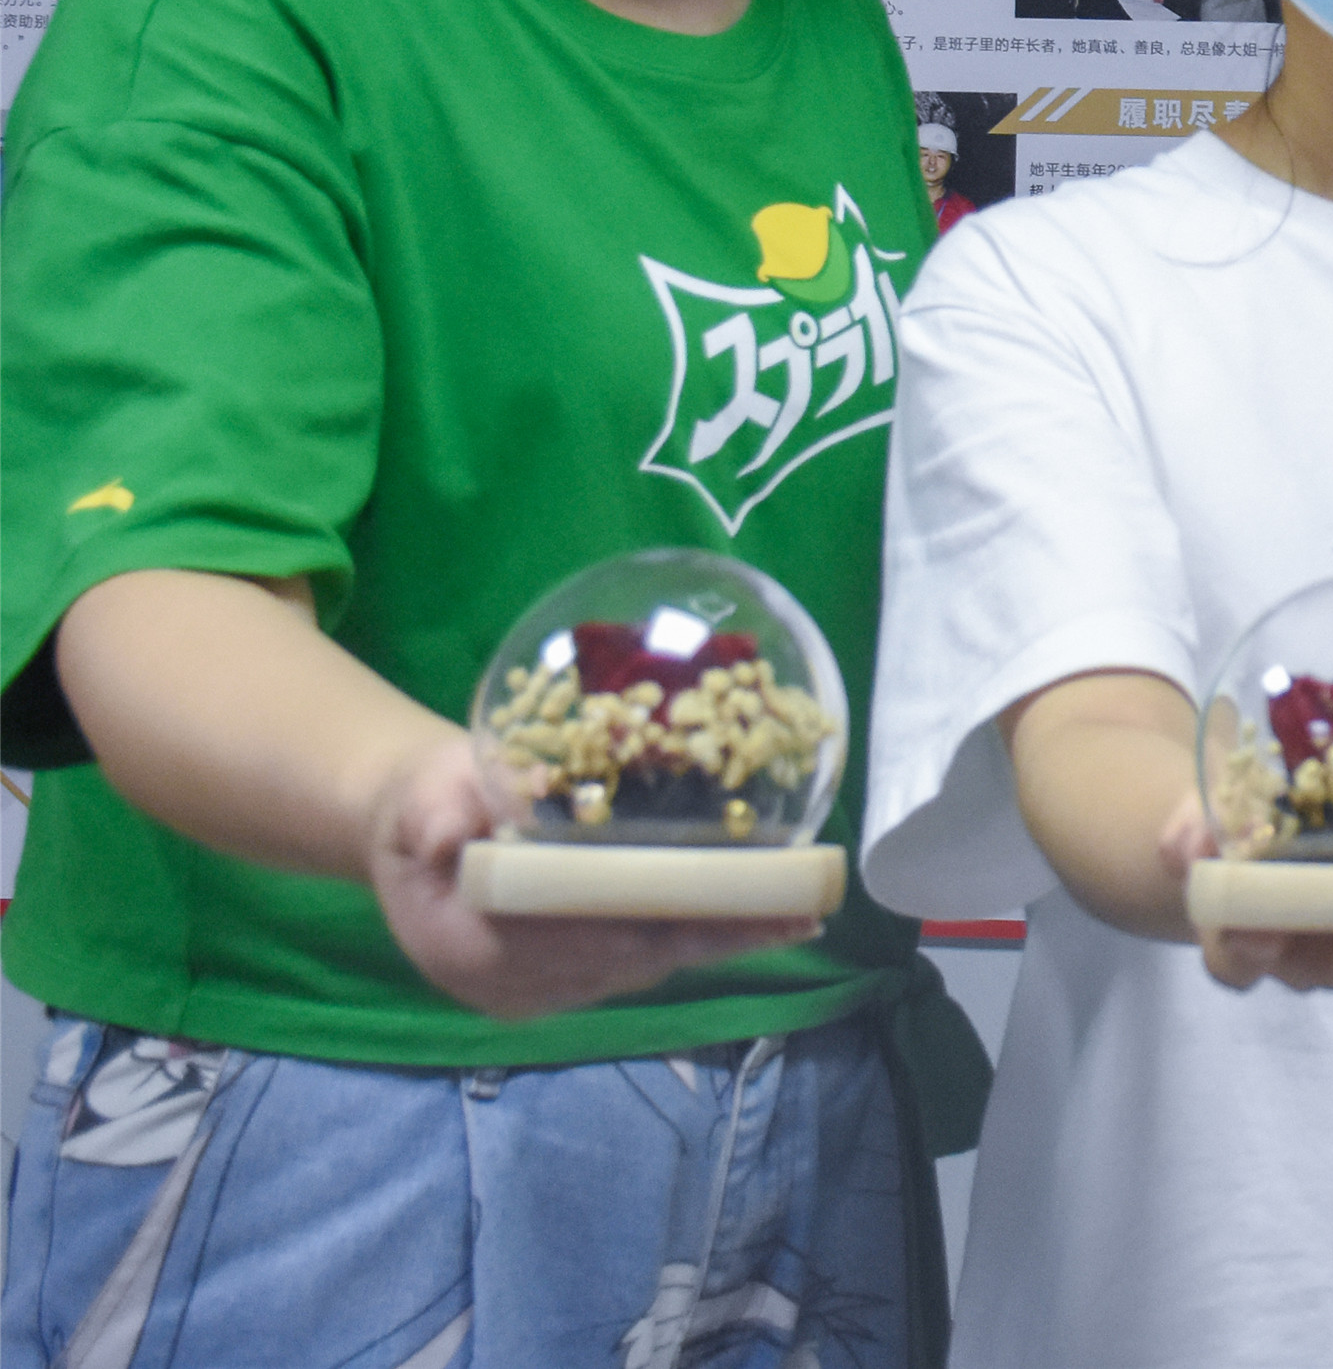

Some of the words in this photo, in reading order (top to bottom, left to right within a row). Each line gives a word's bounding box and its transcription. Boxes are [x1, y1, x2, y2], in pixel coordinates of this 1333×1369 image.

[896, 35, 1285, 57] 子，是班子里的年长者，她真诚、善良，总是像大姐一样
[1029, 162, 1134, 178] 她平生每年2
